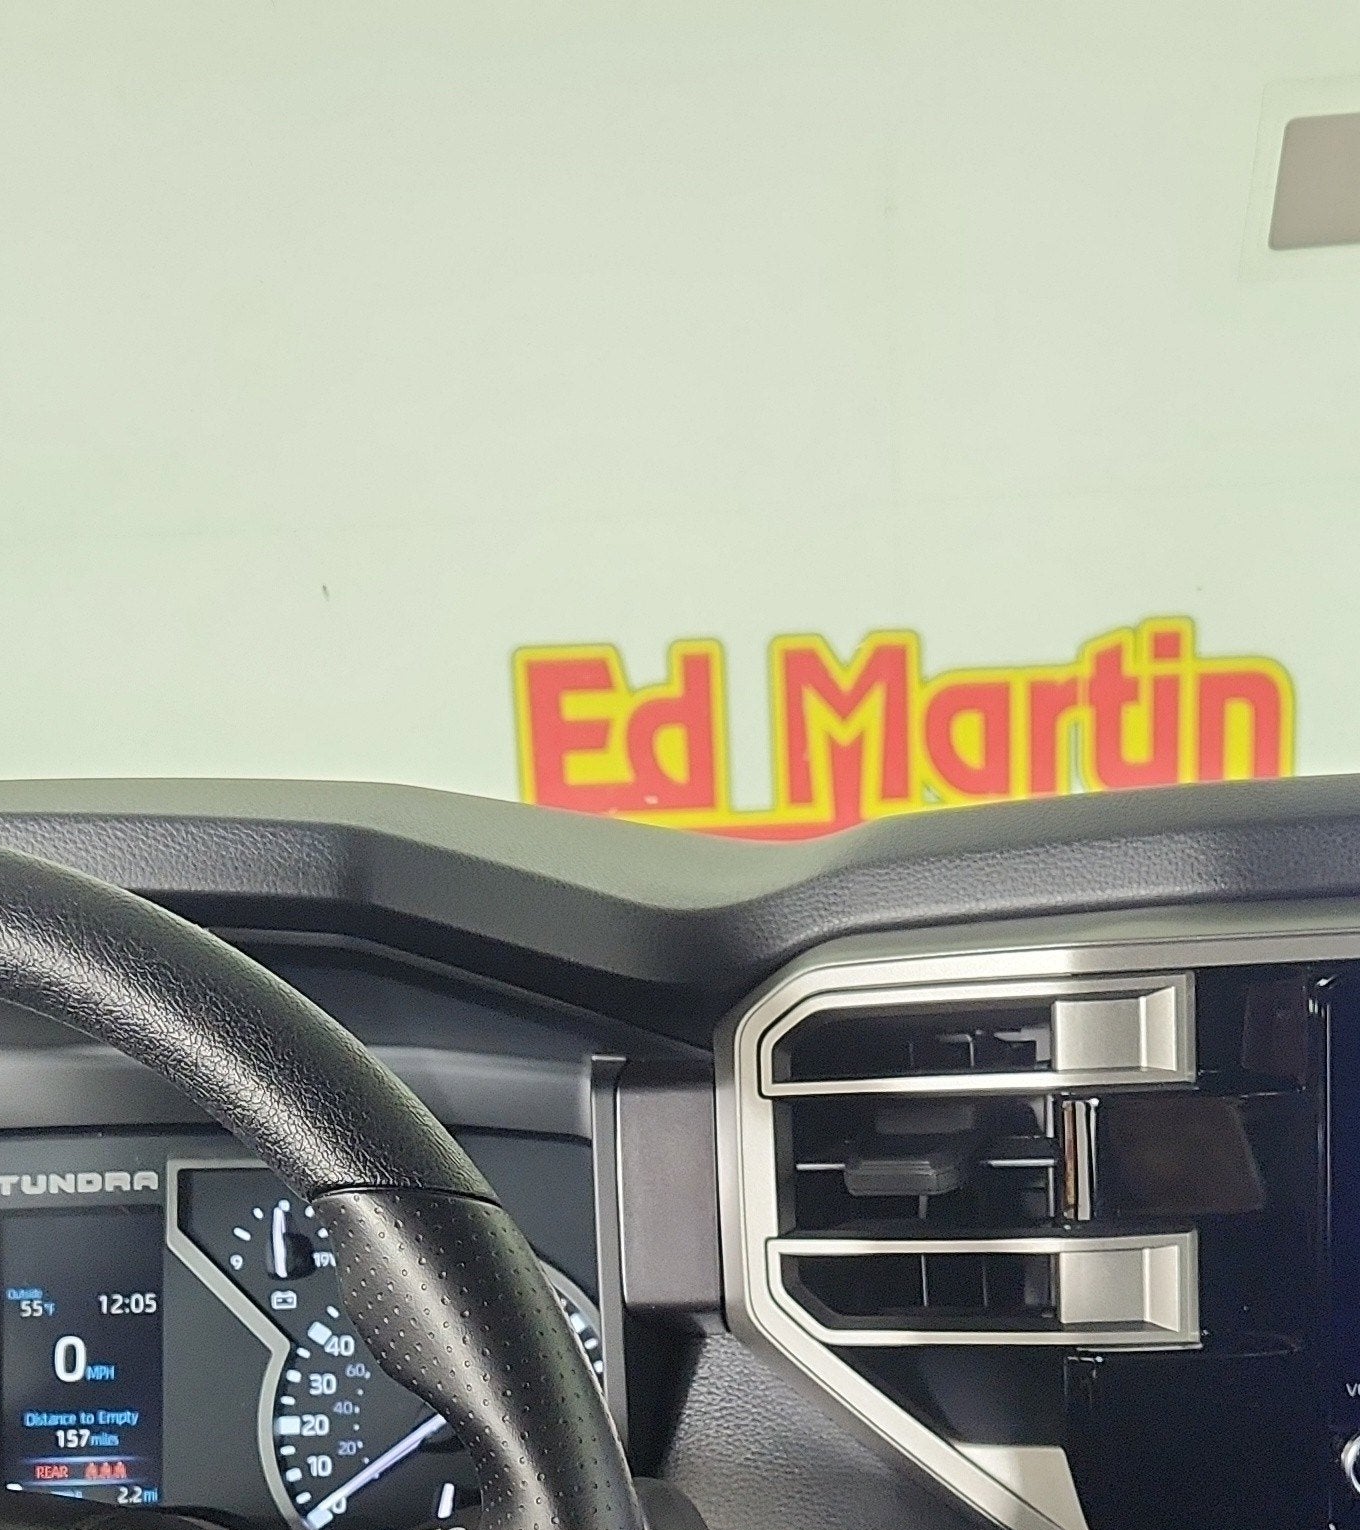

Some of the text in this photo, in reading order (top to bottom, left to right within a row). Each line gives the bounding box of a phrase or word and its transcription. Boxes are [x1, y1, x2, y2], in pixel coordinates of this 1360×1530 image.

[522, 625, 1286, 816] Ed Martin
[229, 1254, 244, 1270] 9
[98, 1292, 158, 1315] 12:05
[324, 1334, 355, 1357] 40
[54, 1335, 116, 1383] 0 MPH
[344, 1362, 366, 1378] 60
[308, 1372, 338, 1396] 30
[333, 1400, 353, 1415] 40
[24, 1409, 139, 1427] Distance to Empty
[301, 1413, 331, 1437] 20
[55, 1428, 120, 1448] 157 miles
[337, 1440, 357, 1456] 20
[34, 1464, 69, 1479] REAR
[306, 1454, 333, 1478] 10
[116, 1485, 159, 1504] 2.2 mi
